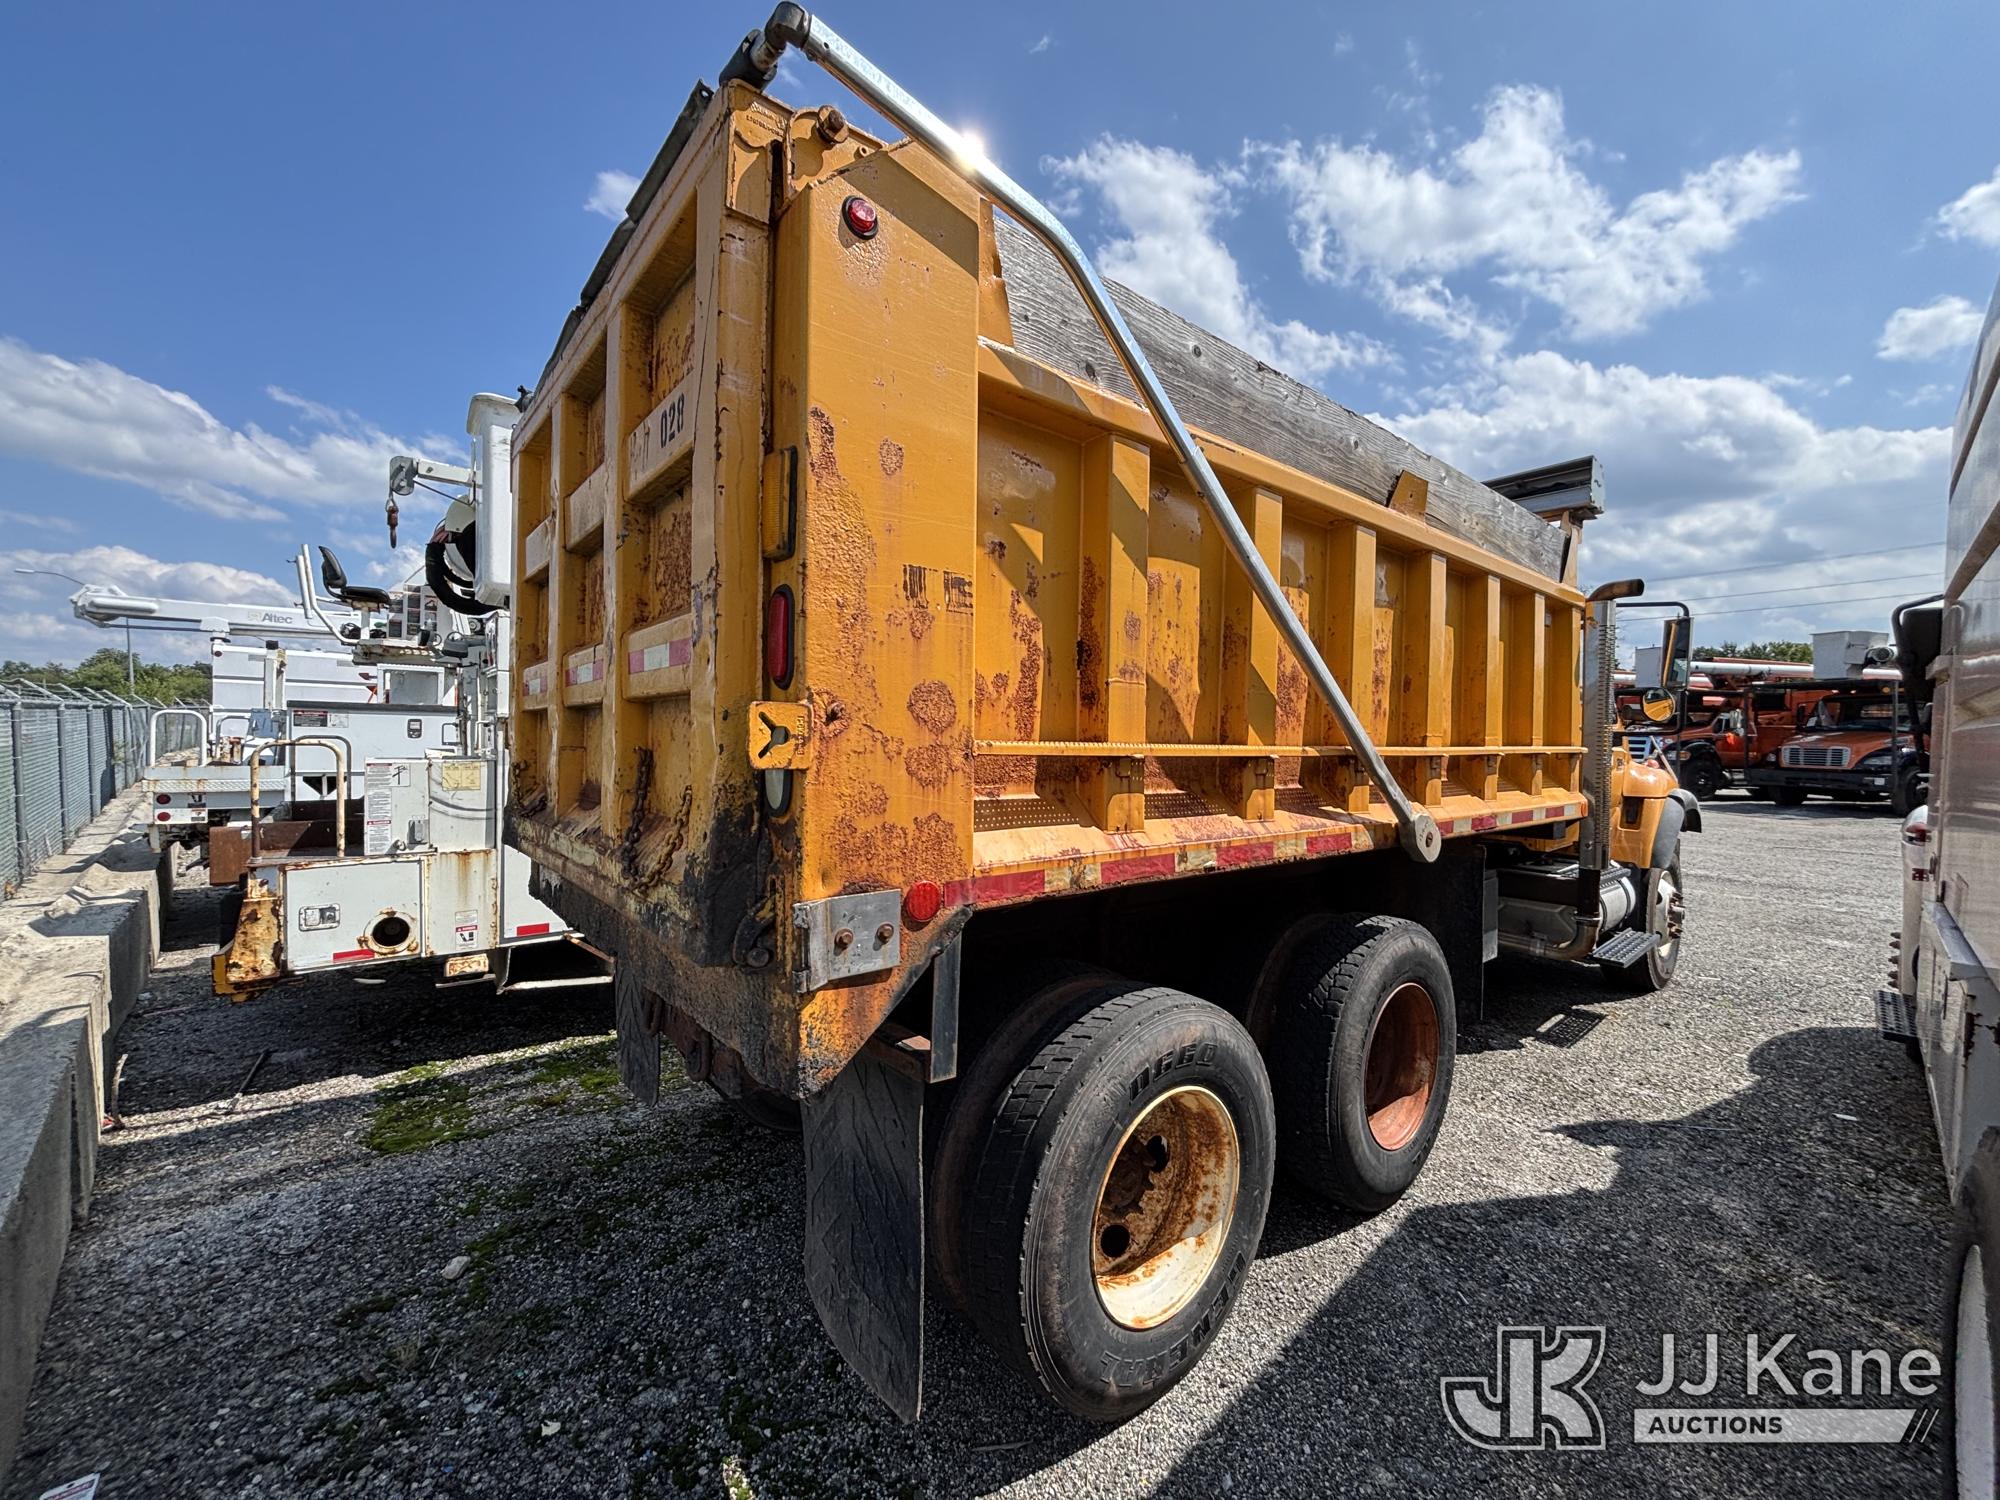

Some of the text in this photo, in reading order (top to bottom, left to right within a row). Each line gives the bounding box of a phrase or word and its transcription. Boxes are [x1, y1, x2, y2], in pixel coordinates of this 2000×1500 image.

[660, 393, 685, 448] 028
[262, 613, 293, 624] Altec
[1100, 1251, 1246, 1388] GENERAL
